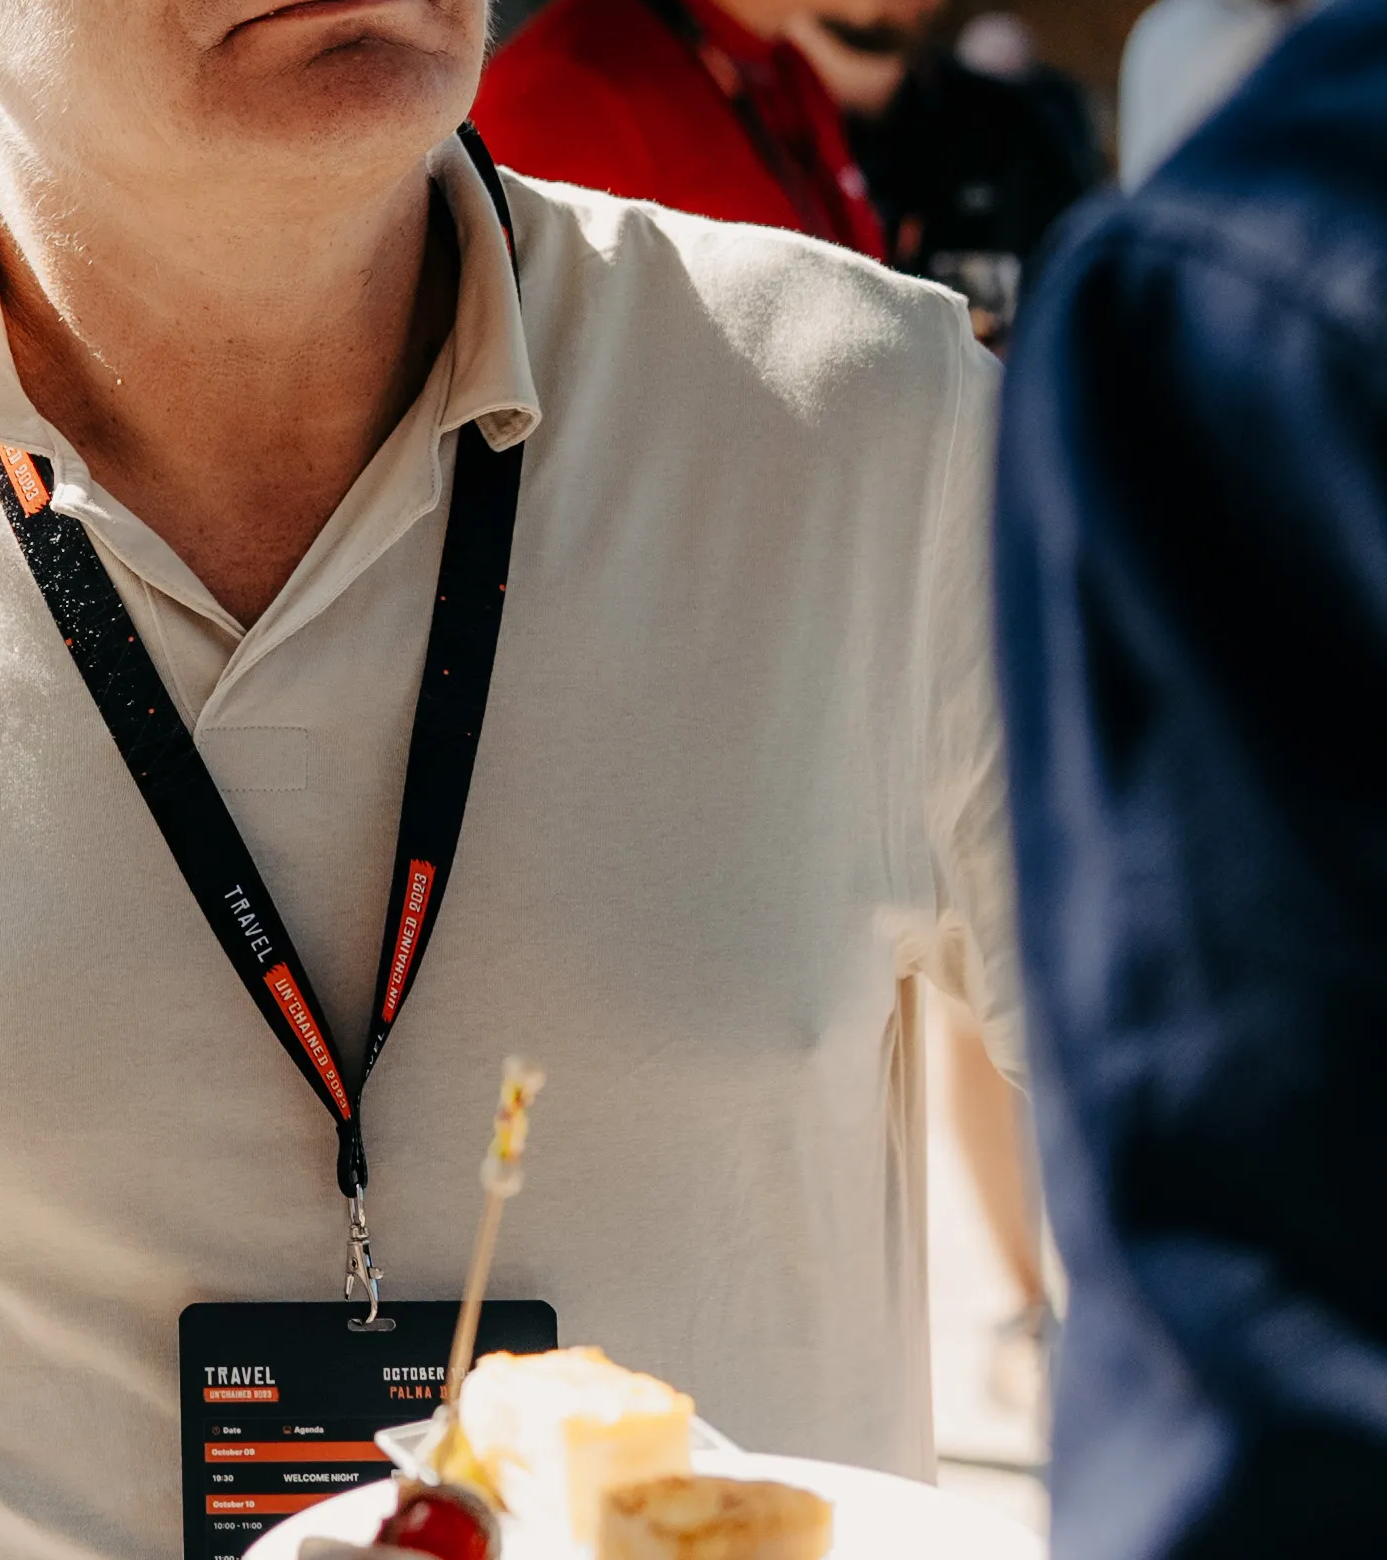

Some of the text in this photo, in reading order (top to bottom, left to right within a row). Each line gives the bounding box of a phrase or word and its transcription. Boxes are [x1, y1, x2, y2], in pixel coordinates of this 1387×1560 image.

[14, 463, 39, 501] 2023
[408, 872, 427, 912] 2023
[224, 884, 273, 963] TRAVEL
[274, 978, 347, 1109] UN'CHAINED 2023
[204, 1366, 276, 1385] TRAVEL
[383, 1367, 445, 1381] OCTOBER
[390, 1385, 432, 1399] PALMA
[222, 1426, 242, 1434] Date
[294, 1426, 324, 1435] Agenda
[211, 1448, 243, 1456] October
[212, 1474, 234, 1482] 19:30
[283, 1473, 359, 1482] WELCOME NIGHT
[212, 1500, 256, 1508] October 10
[213, 1522, 235, 1530] 10:00
[242, 1522, 263, 1530] 11:00
